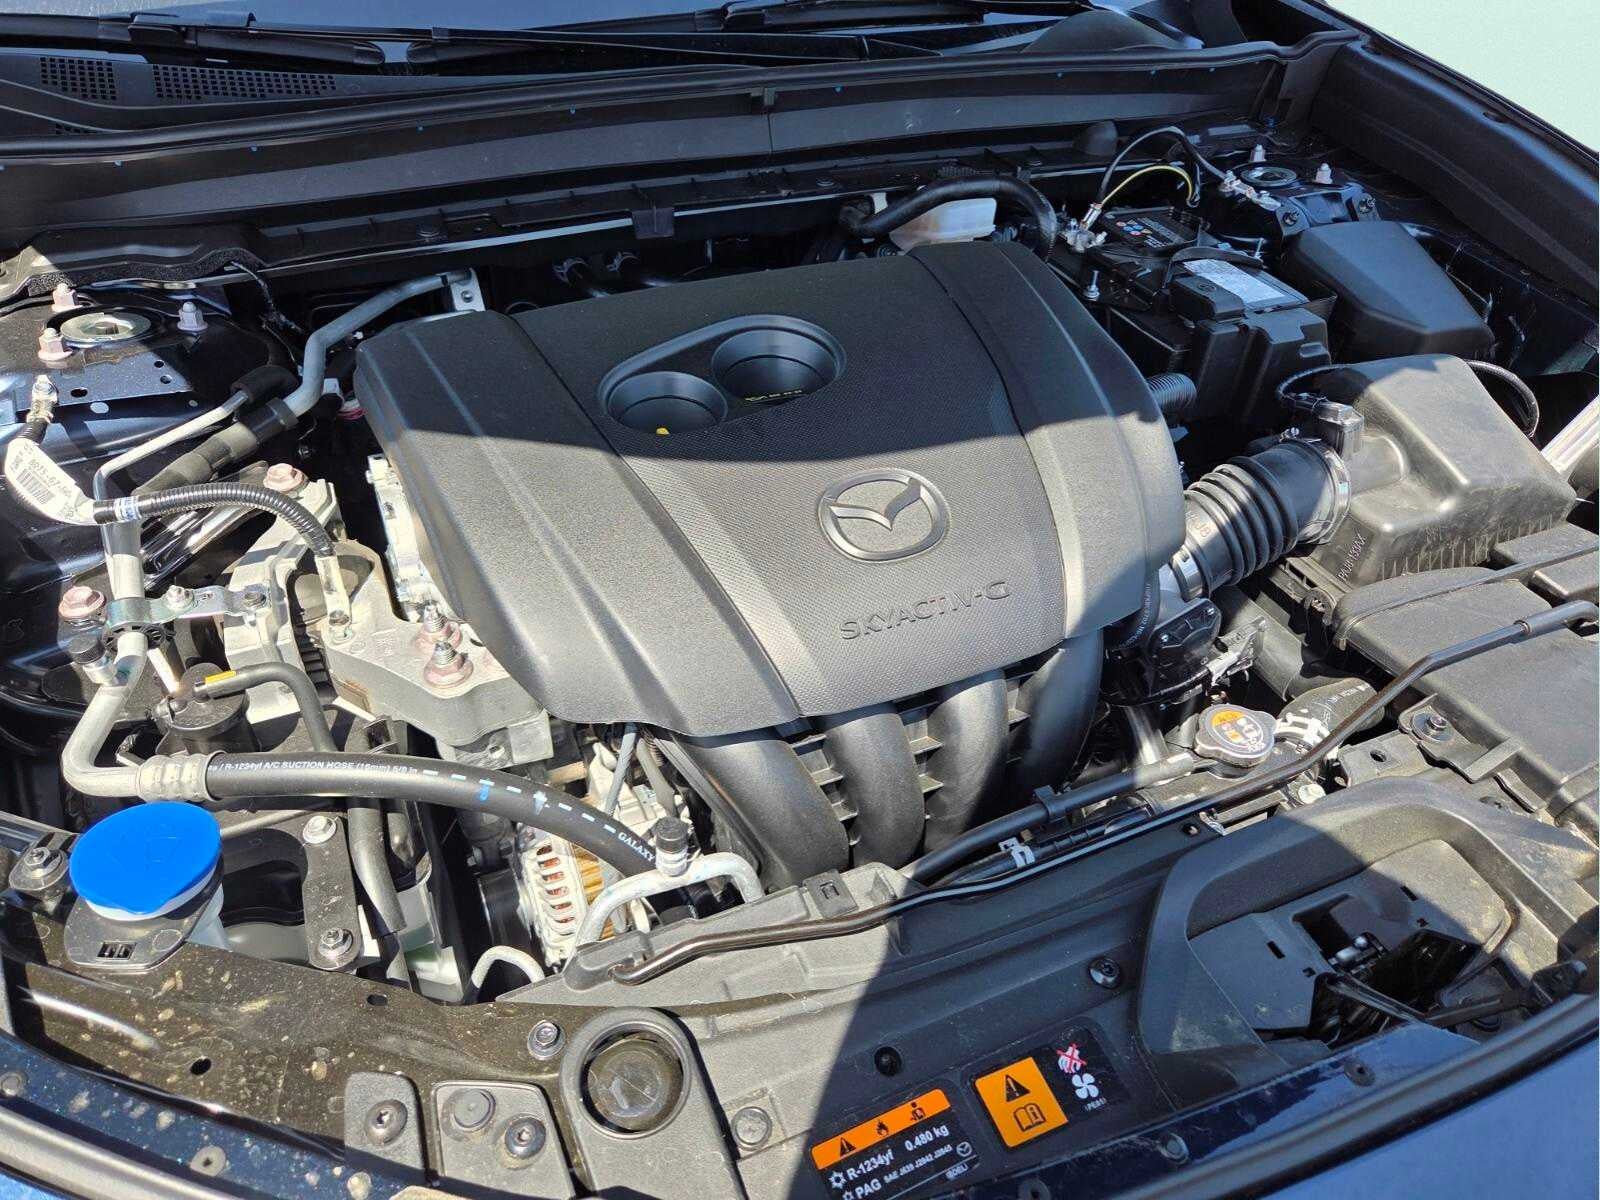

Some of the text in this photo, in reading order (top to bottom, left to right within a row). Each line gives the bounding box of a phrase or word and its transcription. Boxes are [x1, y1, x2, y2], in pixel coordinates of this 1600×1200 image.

[840, 580, 1011, 640] SKYACTIV-G
[263, 761, 281, 770] A/C
[281, 760, 323, 770] SUCTION
[326, 761, 354, 770] HOSE
[847, 1124, 949, 1180] R-1234yf 0.480 kg
[855, 1178, 882, 1199] PAG
